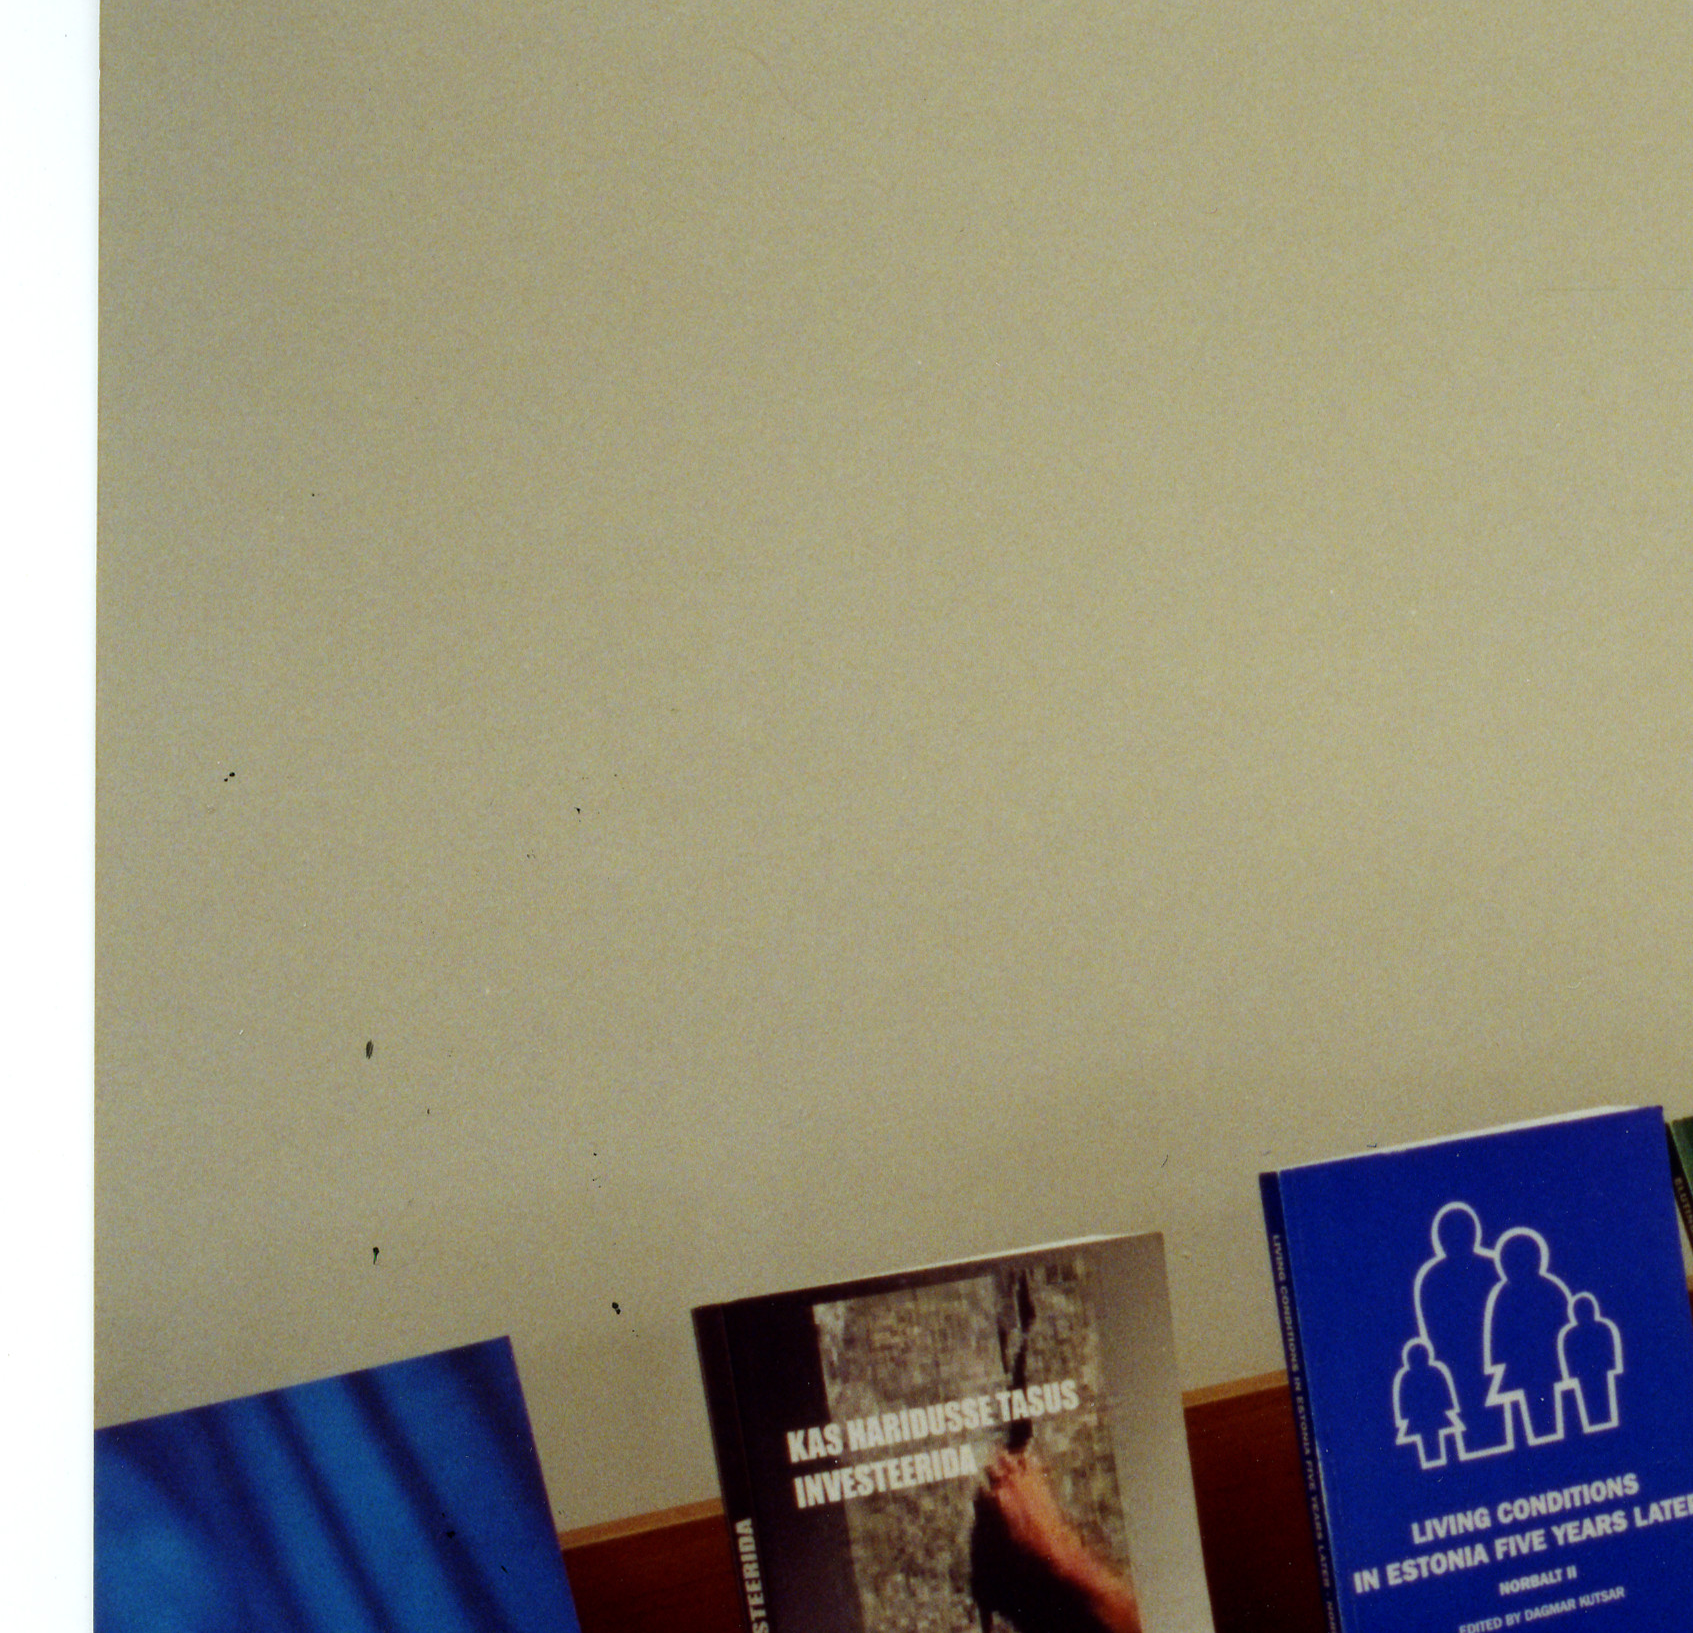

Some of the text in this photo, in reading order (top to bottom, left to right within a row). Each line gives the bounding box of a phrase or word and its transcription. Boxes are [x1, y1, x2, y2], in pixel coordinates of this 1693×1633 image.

[1271, 1233, 1286, 1282] LIVING
[1278, 1284, 1300, 1372] CONDITIONS
[1292, 1375, 1303, 1392] IN
[786, 1378, 1080, 1464] KAS HARIDUSSE TASUS
[1294, 1393, 1312, 1456] ESTONIA
[793, 1442, 978, 1510] INVESTEERIDA
[1304, 1458, 1317, 1491] FIVE
[1310, 1493, 1325, 1540] YEARS
[1411, 1471, 1640, 1545] LIVING CONDITIONS
[1317, 1543, 1332, 1588] LATER
[1352, 1567, 1381, 1594] IN
[1385, 1542, 1490, 1587] ESTONIA
[1493, 1529, 1548, 1561] FIVE
[1551, 1509, 1629, 1547] YEARS
[1498, 1564, 1578, 1596] NORBALT II
[1505, 1610, 1522, 1628] BY
[1523, 1596, 1577, 1623] DAGMAR
[1577, 1584, 1627, 1612] KUTSAR
